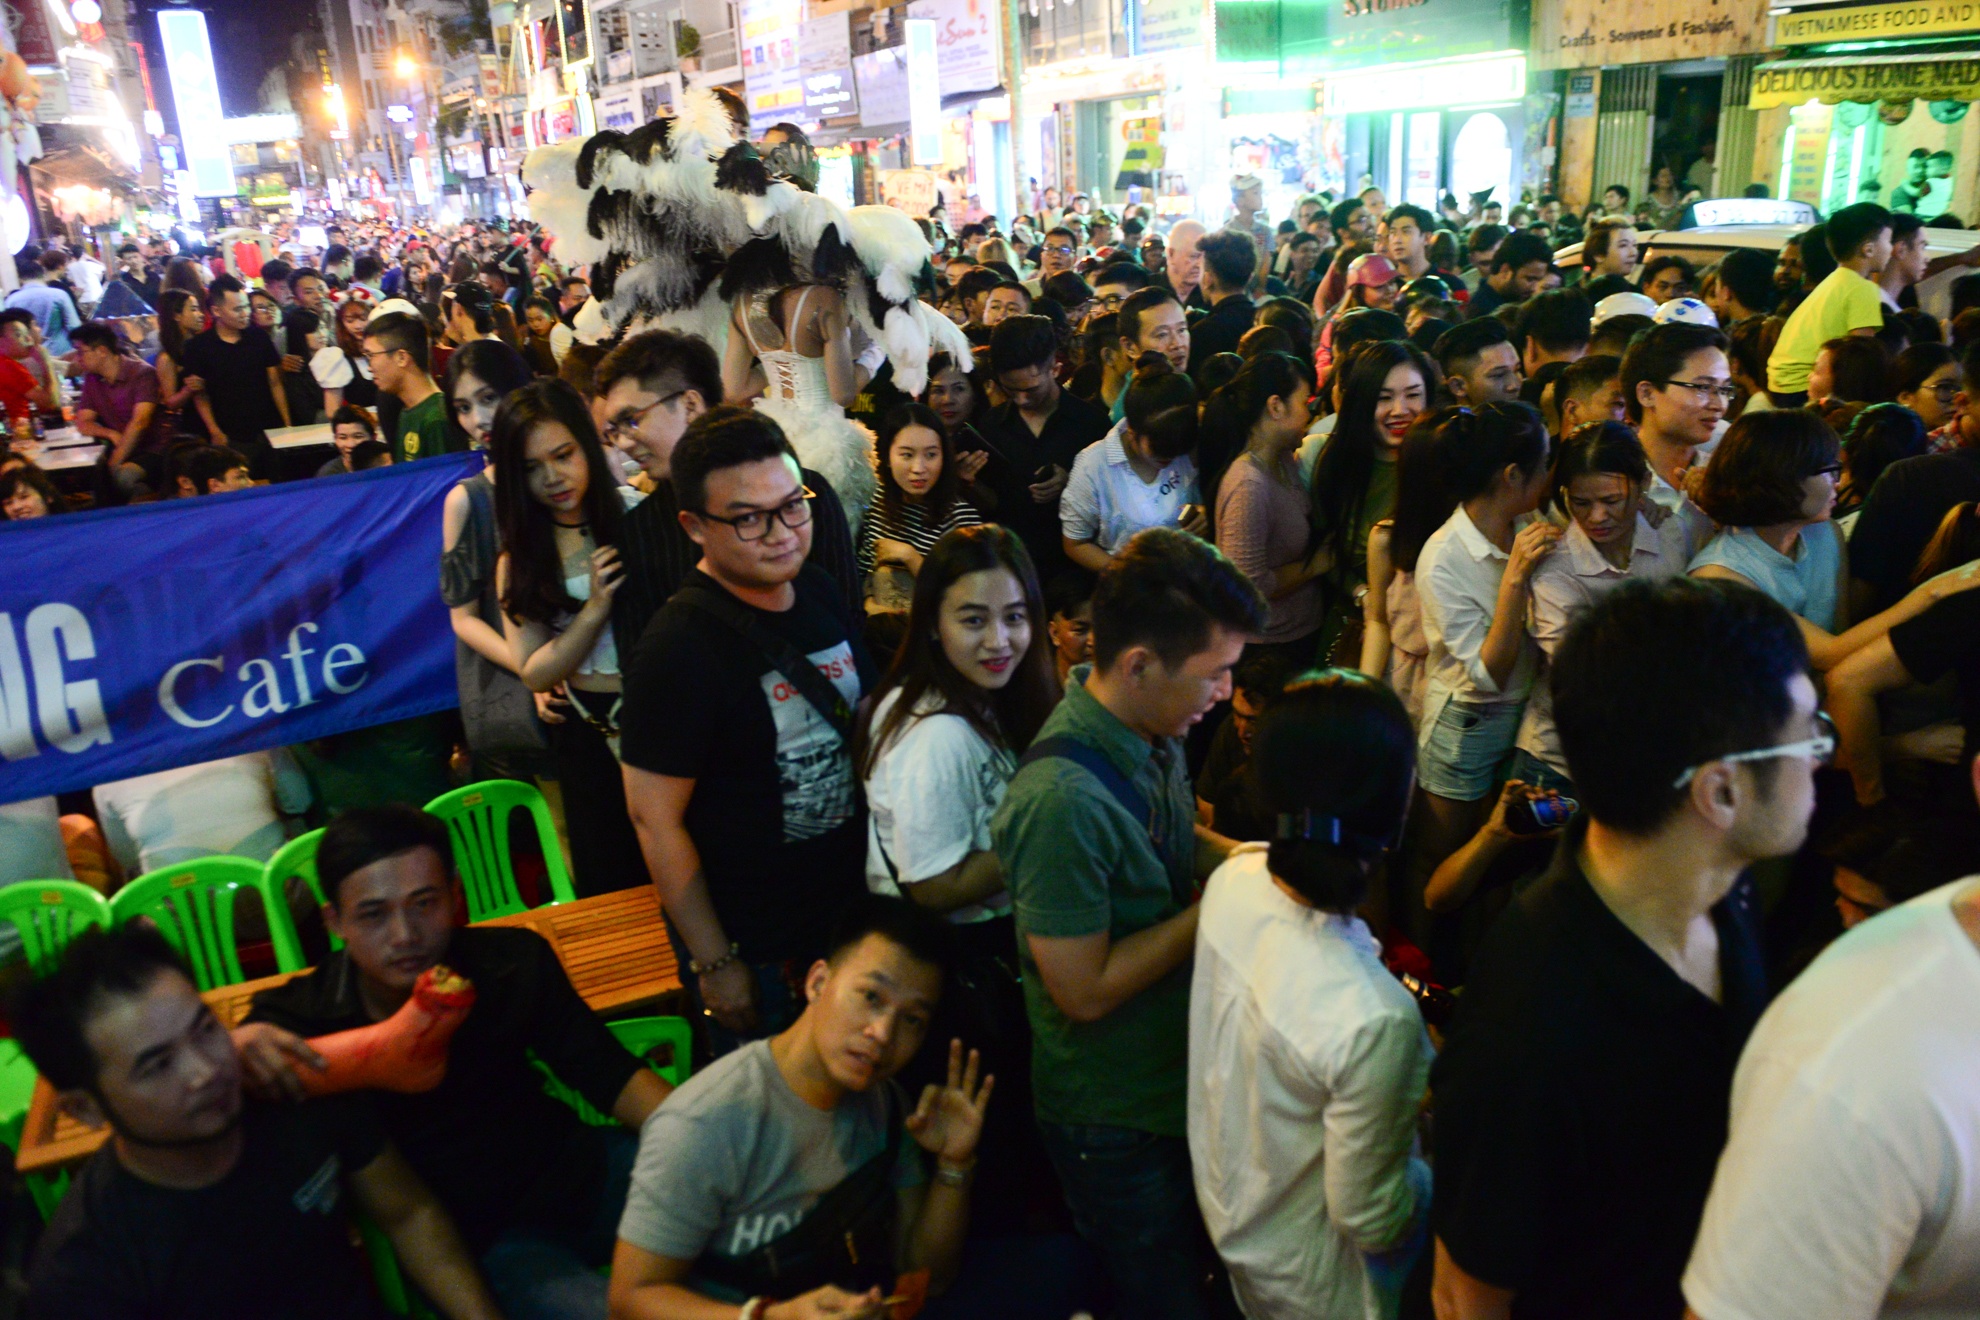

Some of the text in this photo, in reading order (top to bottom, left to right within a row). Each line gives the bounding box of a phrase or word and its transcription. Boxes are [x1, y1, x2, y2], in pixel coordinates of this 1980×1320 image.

[1559, 28, 1596, 48] Crafts
[1609, 26, 1664, 44] Souvenir
[1668, 23, 1677, 37] &
[1682, 15, 1735, 36] Fashion
[1782, 4, 1973, 38] VIETNAMESE FOOD AND
[1756, 67, 1856, 94] DELICIOUS
[1862, 64, 1924, 89] HOME
[157, 621, 370, 729] Cafe
